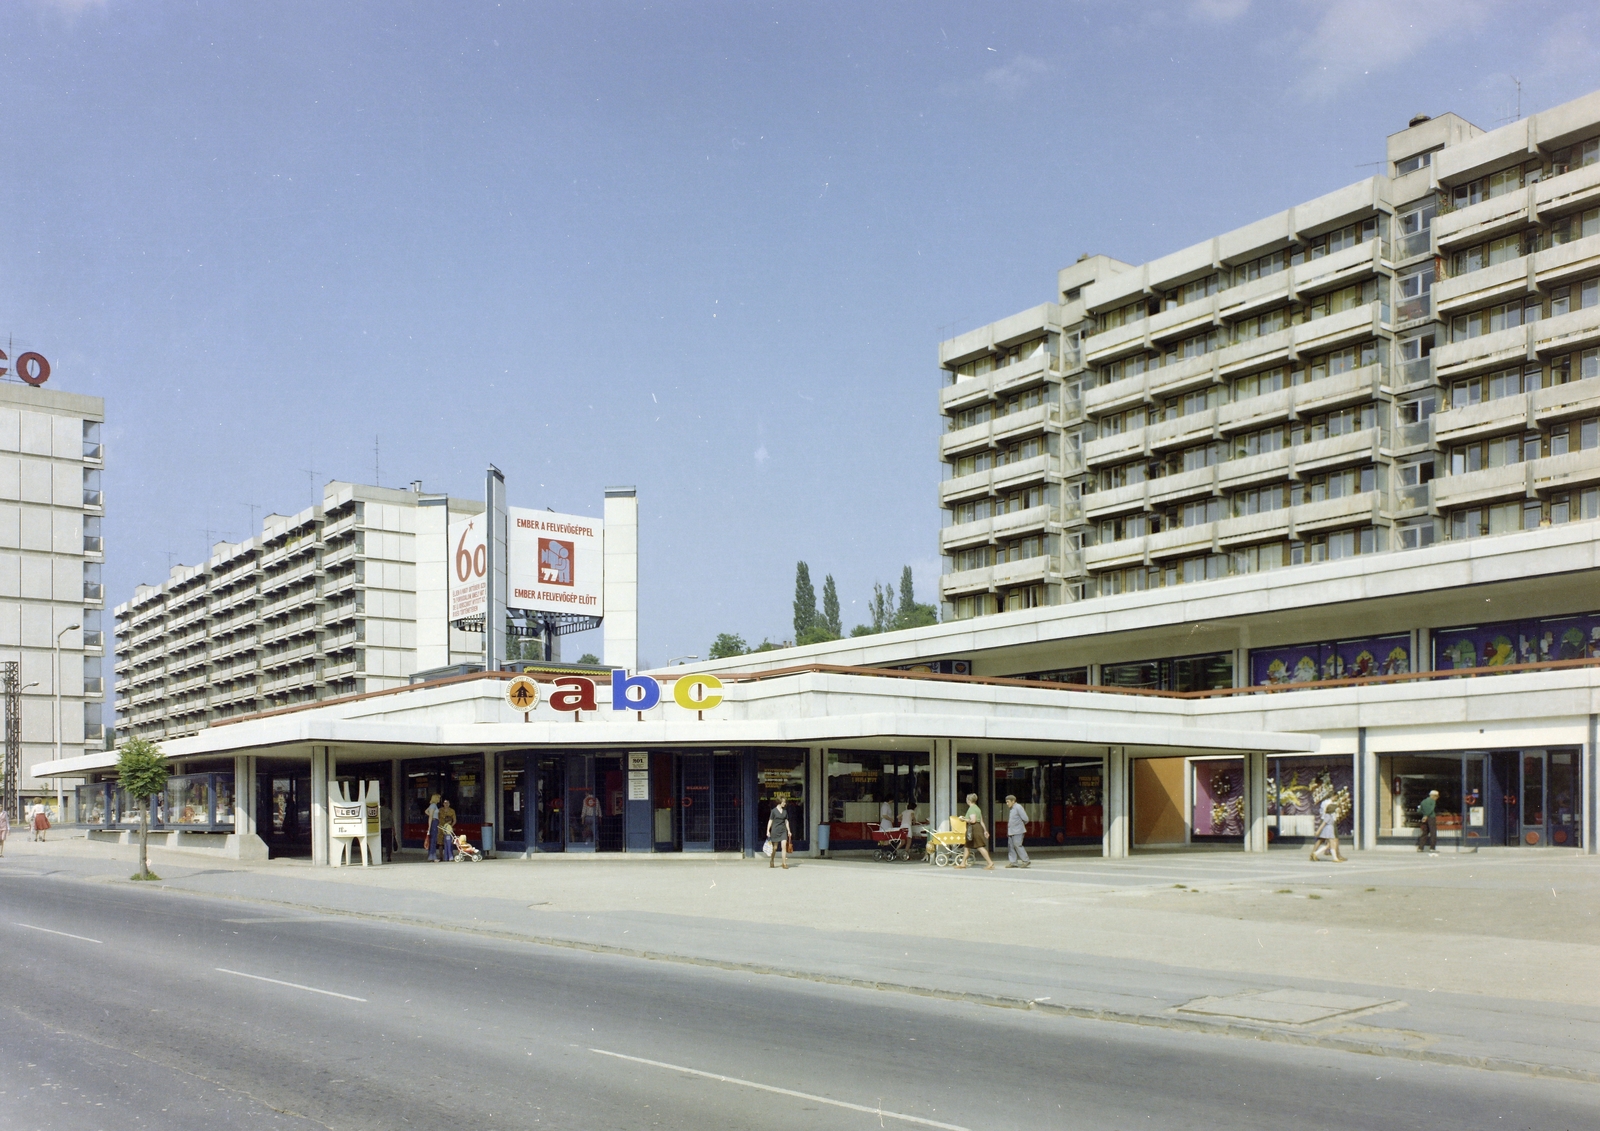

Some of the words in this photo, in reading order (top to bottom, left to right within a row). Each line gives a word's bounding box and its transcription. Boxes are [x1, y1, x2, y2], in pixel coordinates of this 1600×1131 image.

[517, 518, 540, 530] EMBER
[541, 522, 545, 530] A
[456, 528, 486, 583] 60
[514, 588, 536, 600] EMBER
[537, 591, 542, 600] A
[548, 669, 724, 712] abc
